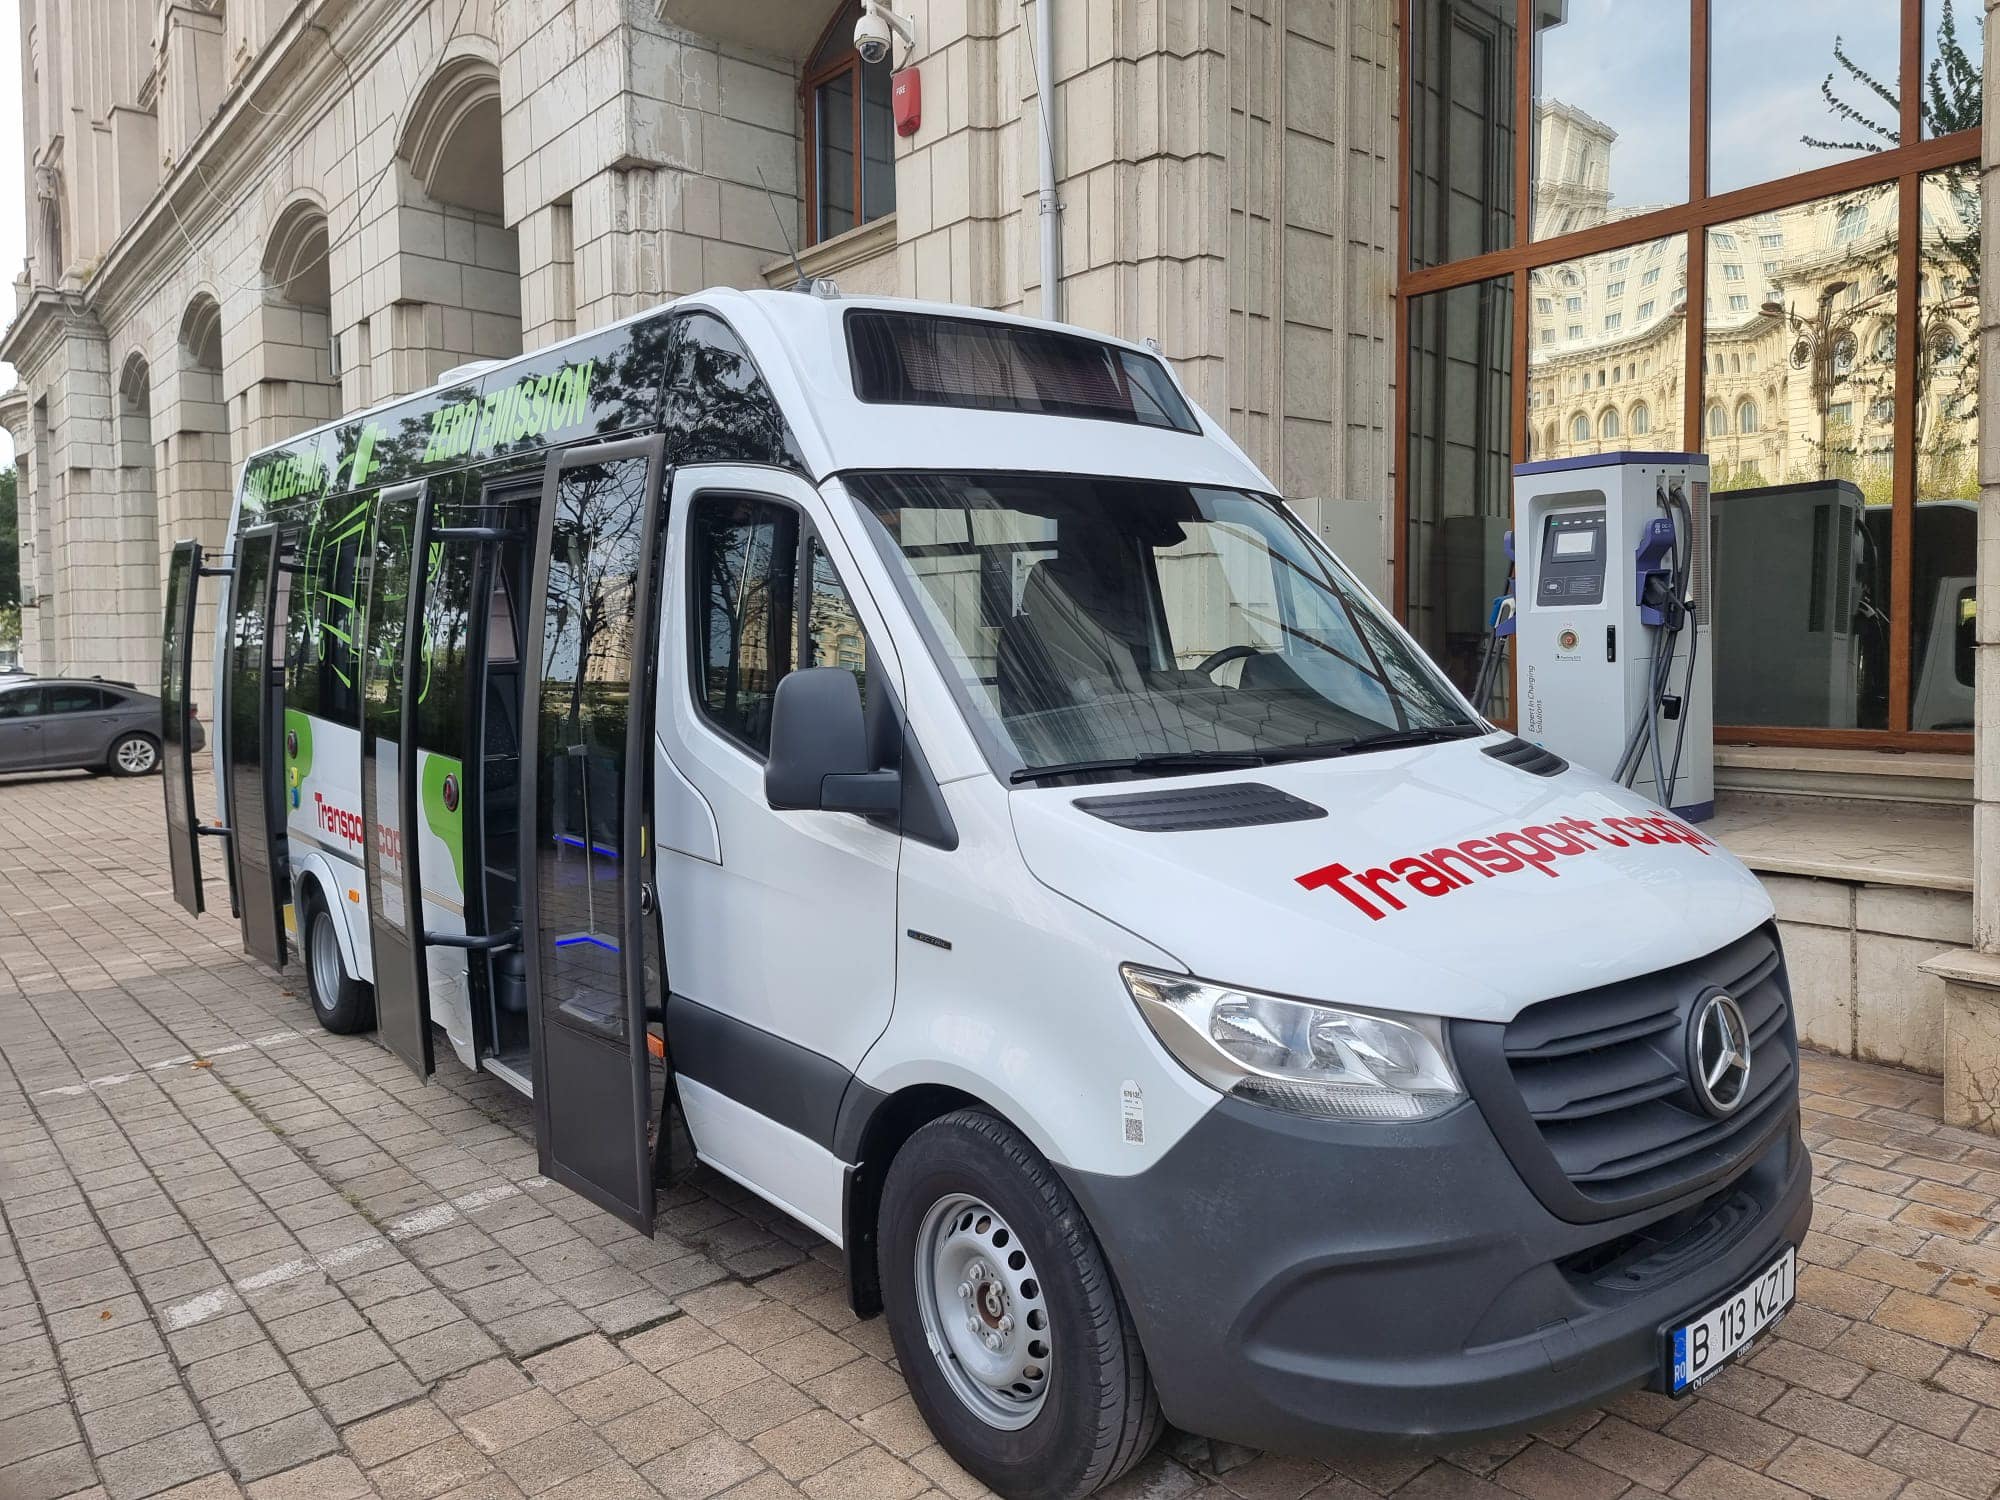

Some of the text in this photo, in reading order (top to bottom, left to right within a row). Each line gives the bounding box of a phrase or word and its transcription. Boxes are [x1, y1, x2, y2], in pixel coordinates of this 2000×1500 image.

[423, 360, 594, 464] ZERO EMISSION
[1528, 665, 1536, 699] Charging
[314, 791, 364, 850] Transpo
[1294, 816, 1631, 921] Transport
[1692, 1259, 1788, 1373] B 113 KZT
[1674, 1361, 1686, 1384] RO
